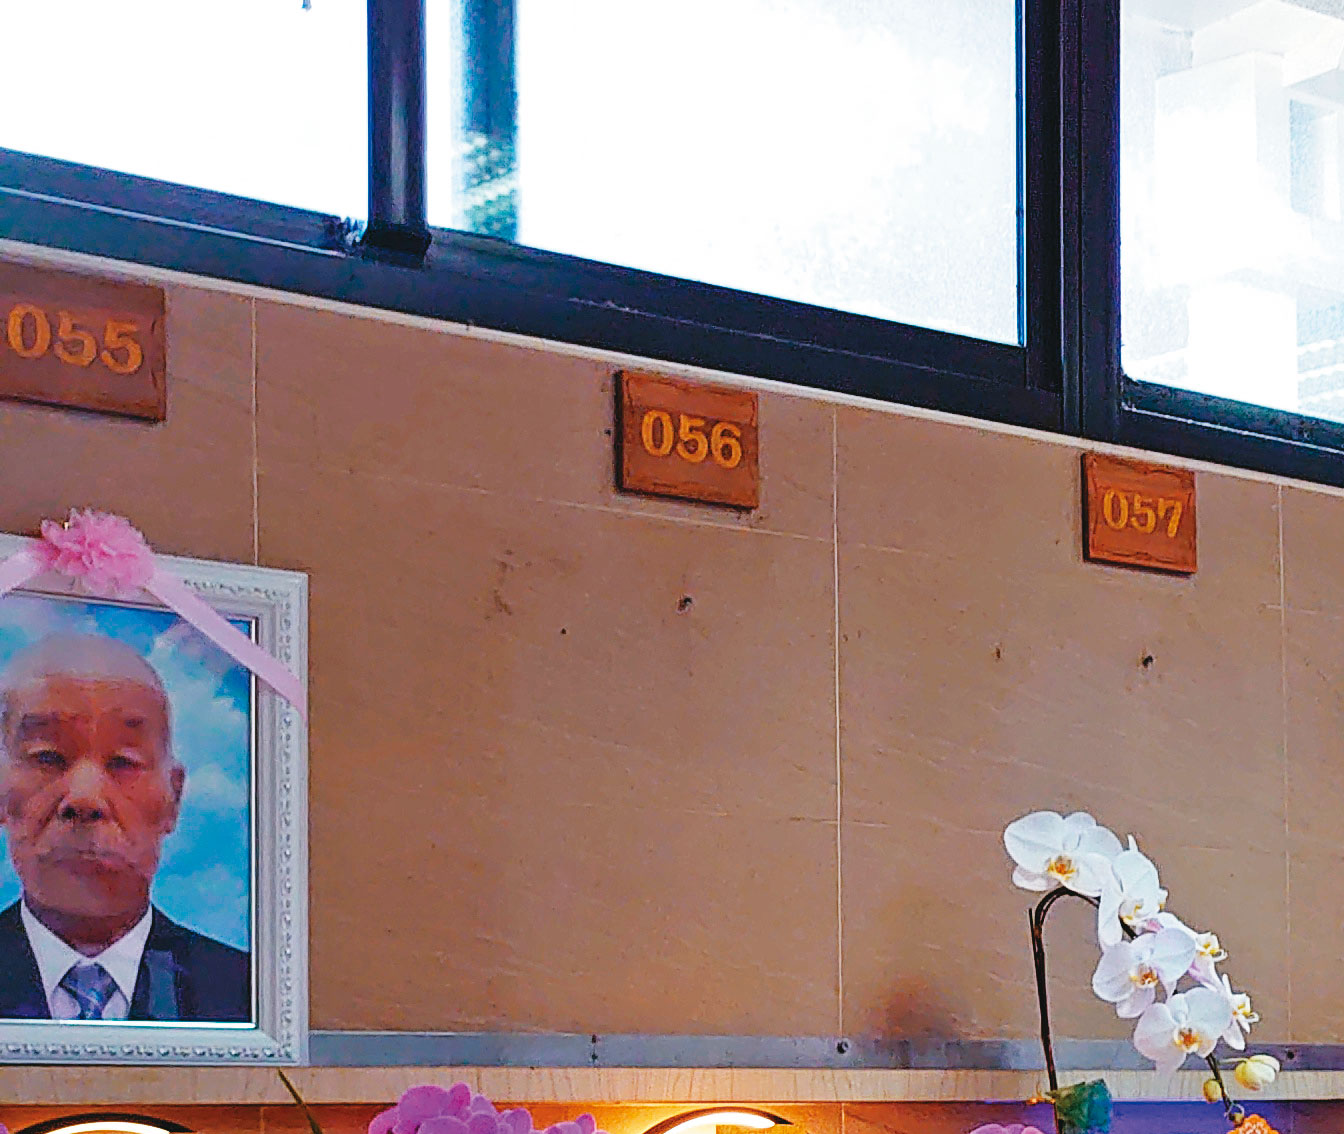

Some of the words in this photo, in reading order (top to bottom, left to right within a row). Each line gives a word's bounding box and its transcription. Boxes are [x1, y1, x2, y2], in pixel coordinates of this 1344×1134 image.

[7, 303, 143, 375] 055
[641, 409, 742, 469] 056
[1102, 488, 1183, 539] 057
